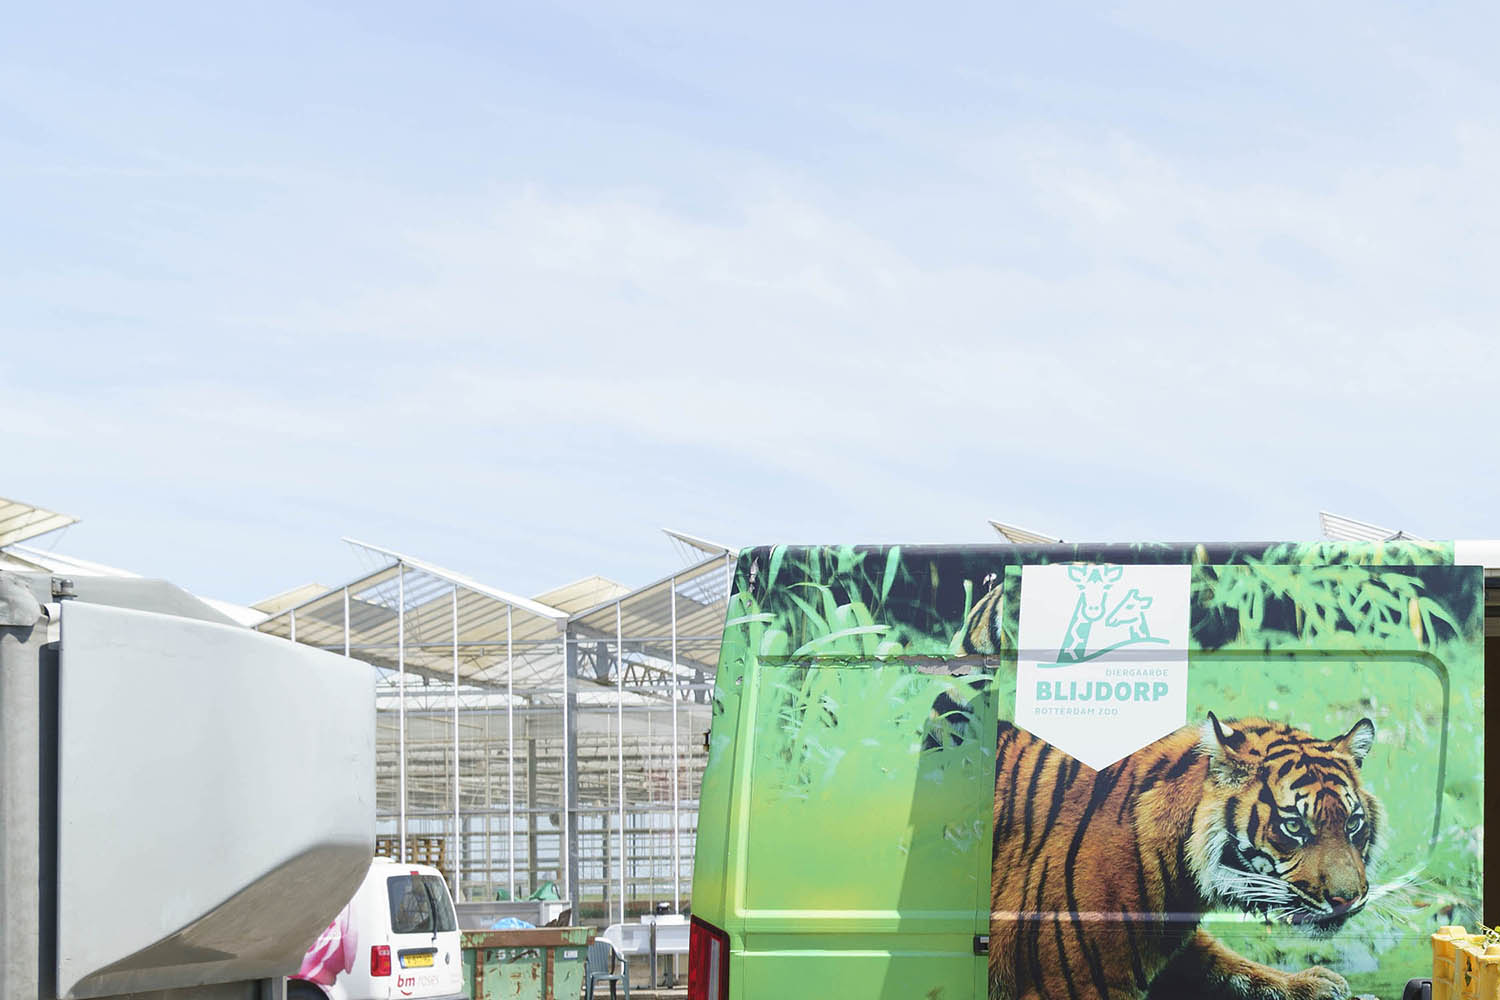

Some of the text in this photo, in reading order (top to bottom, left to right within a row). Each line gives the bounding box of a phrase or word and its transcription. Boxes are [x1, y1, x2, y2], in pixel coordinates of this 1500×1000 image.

[1105, 668, 1169, 677] DIERGAARDE
[1035, 681, 1169, 702] BLIJDORP
[1034, 707, 1119, 716] ROTTERDAM ZOO
[396, 974, 416, 988] bm
